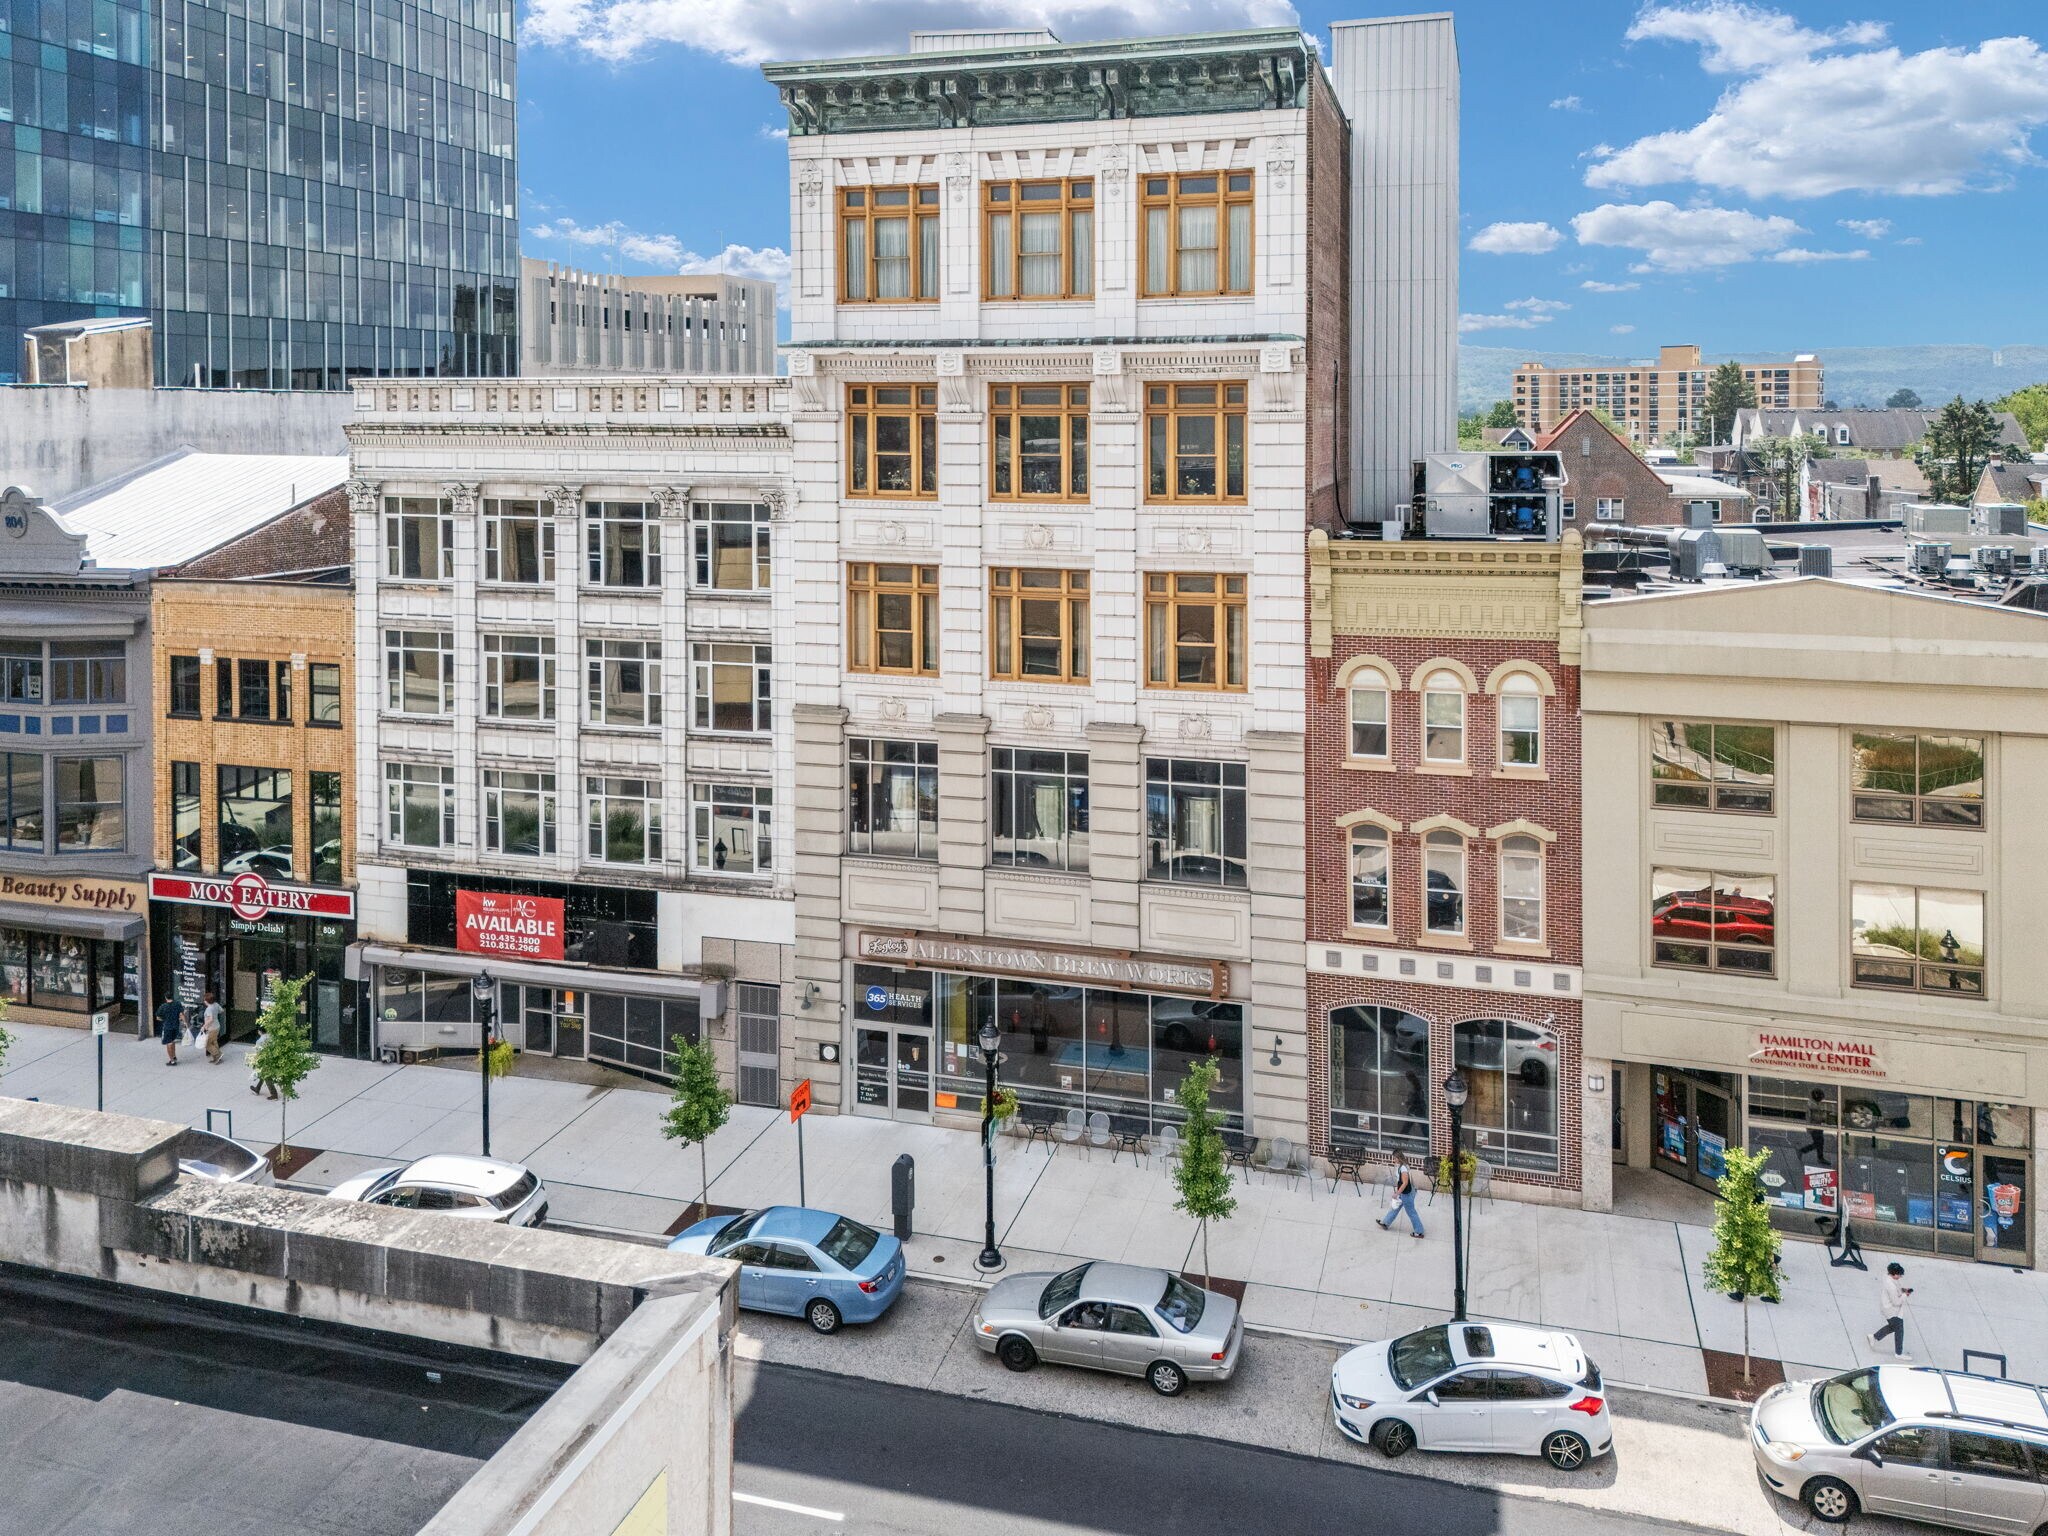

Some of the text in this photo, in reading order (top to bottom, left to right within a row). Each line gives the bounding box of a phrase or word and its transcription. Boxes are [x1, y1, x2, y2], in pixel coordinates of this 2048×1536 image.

[1, 877, 136, 910] Beauty Supply
[189, 882, 312, 910] MO'S EATERY
[230, 920, 284, 933] Simply Delish!
[322, 927, 336, 935] 806
[465, 914, 556, 936] AVAILABLE
[479, 933, 540, 944] 610.435.1800
[479, 940, 540, 953] 210.816.2966
[914, 943, 1046, 969] ALLENTOWN
[1053, 956, 1119, 977] BREW
[1126, 963, 1212, 988] WORKS
[868, 993, 886, 1003] 365
[888, 993, 922, 1003] HEALTH
[888, 1000, 922, 1009] SERVICES
[1759, 1034, 1876, 1056] HAMILTON MALL
[1764, 1047, 1871, 1067] FAMILY CENTER
[1333, 1025, 1343, 1107] BREWERY
[1750, 1058, 1796, 1067] CONVENIENCE
[1798, 1062, 1818, 1070] STORE
[1827, 1066, 1858, 1074] TOBACCO
[1861, 1069, 1886, 1077] OUTLET
[1940, 1174, 1972, 1184] CELSIUS
